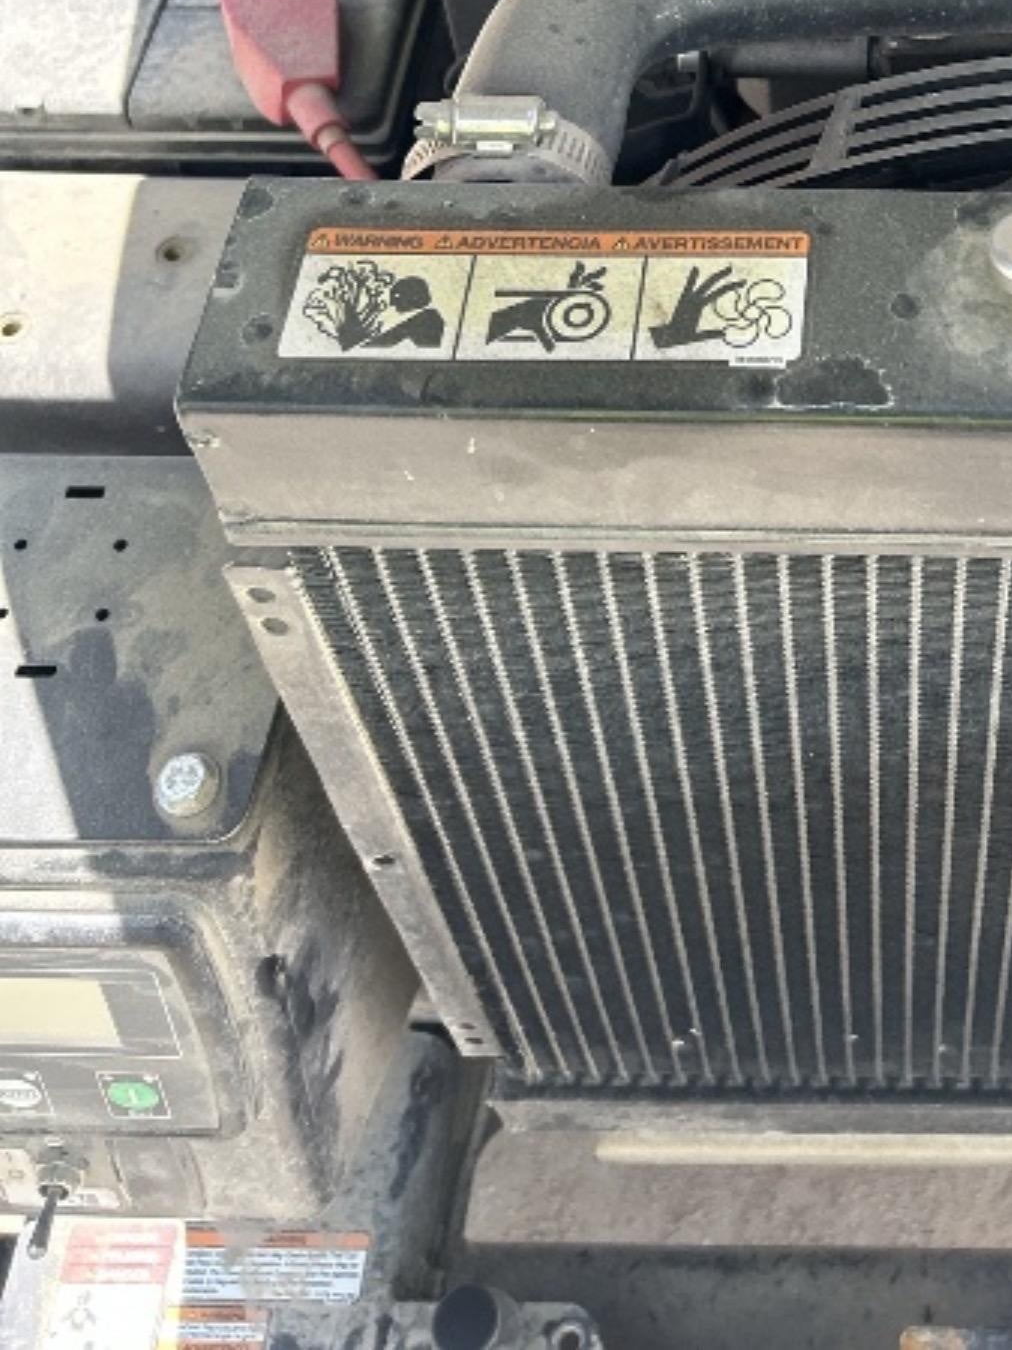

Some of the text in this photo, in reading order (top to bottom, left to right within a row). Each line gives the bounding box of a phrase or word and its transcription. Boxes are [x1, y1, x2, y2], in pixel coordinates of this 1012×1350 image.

[335, 233, 805, 251] WARNING ADVERTENCIA AVERTISSEMENT
